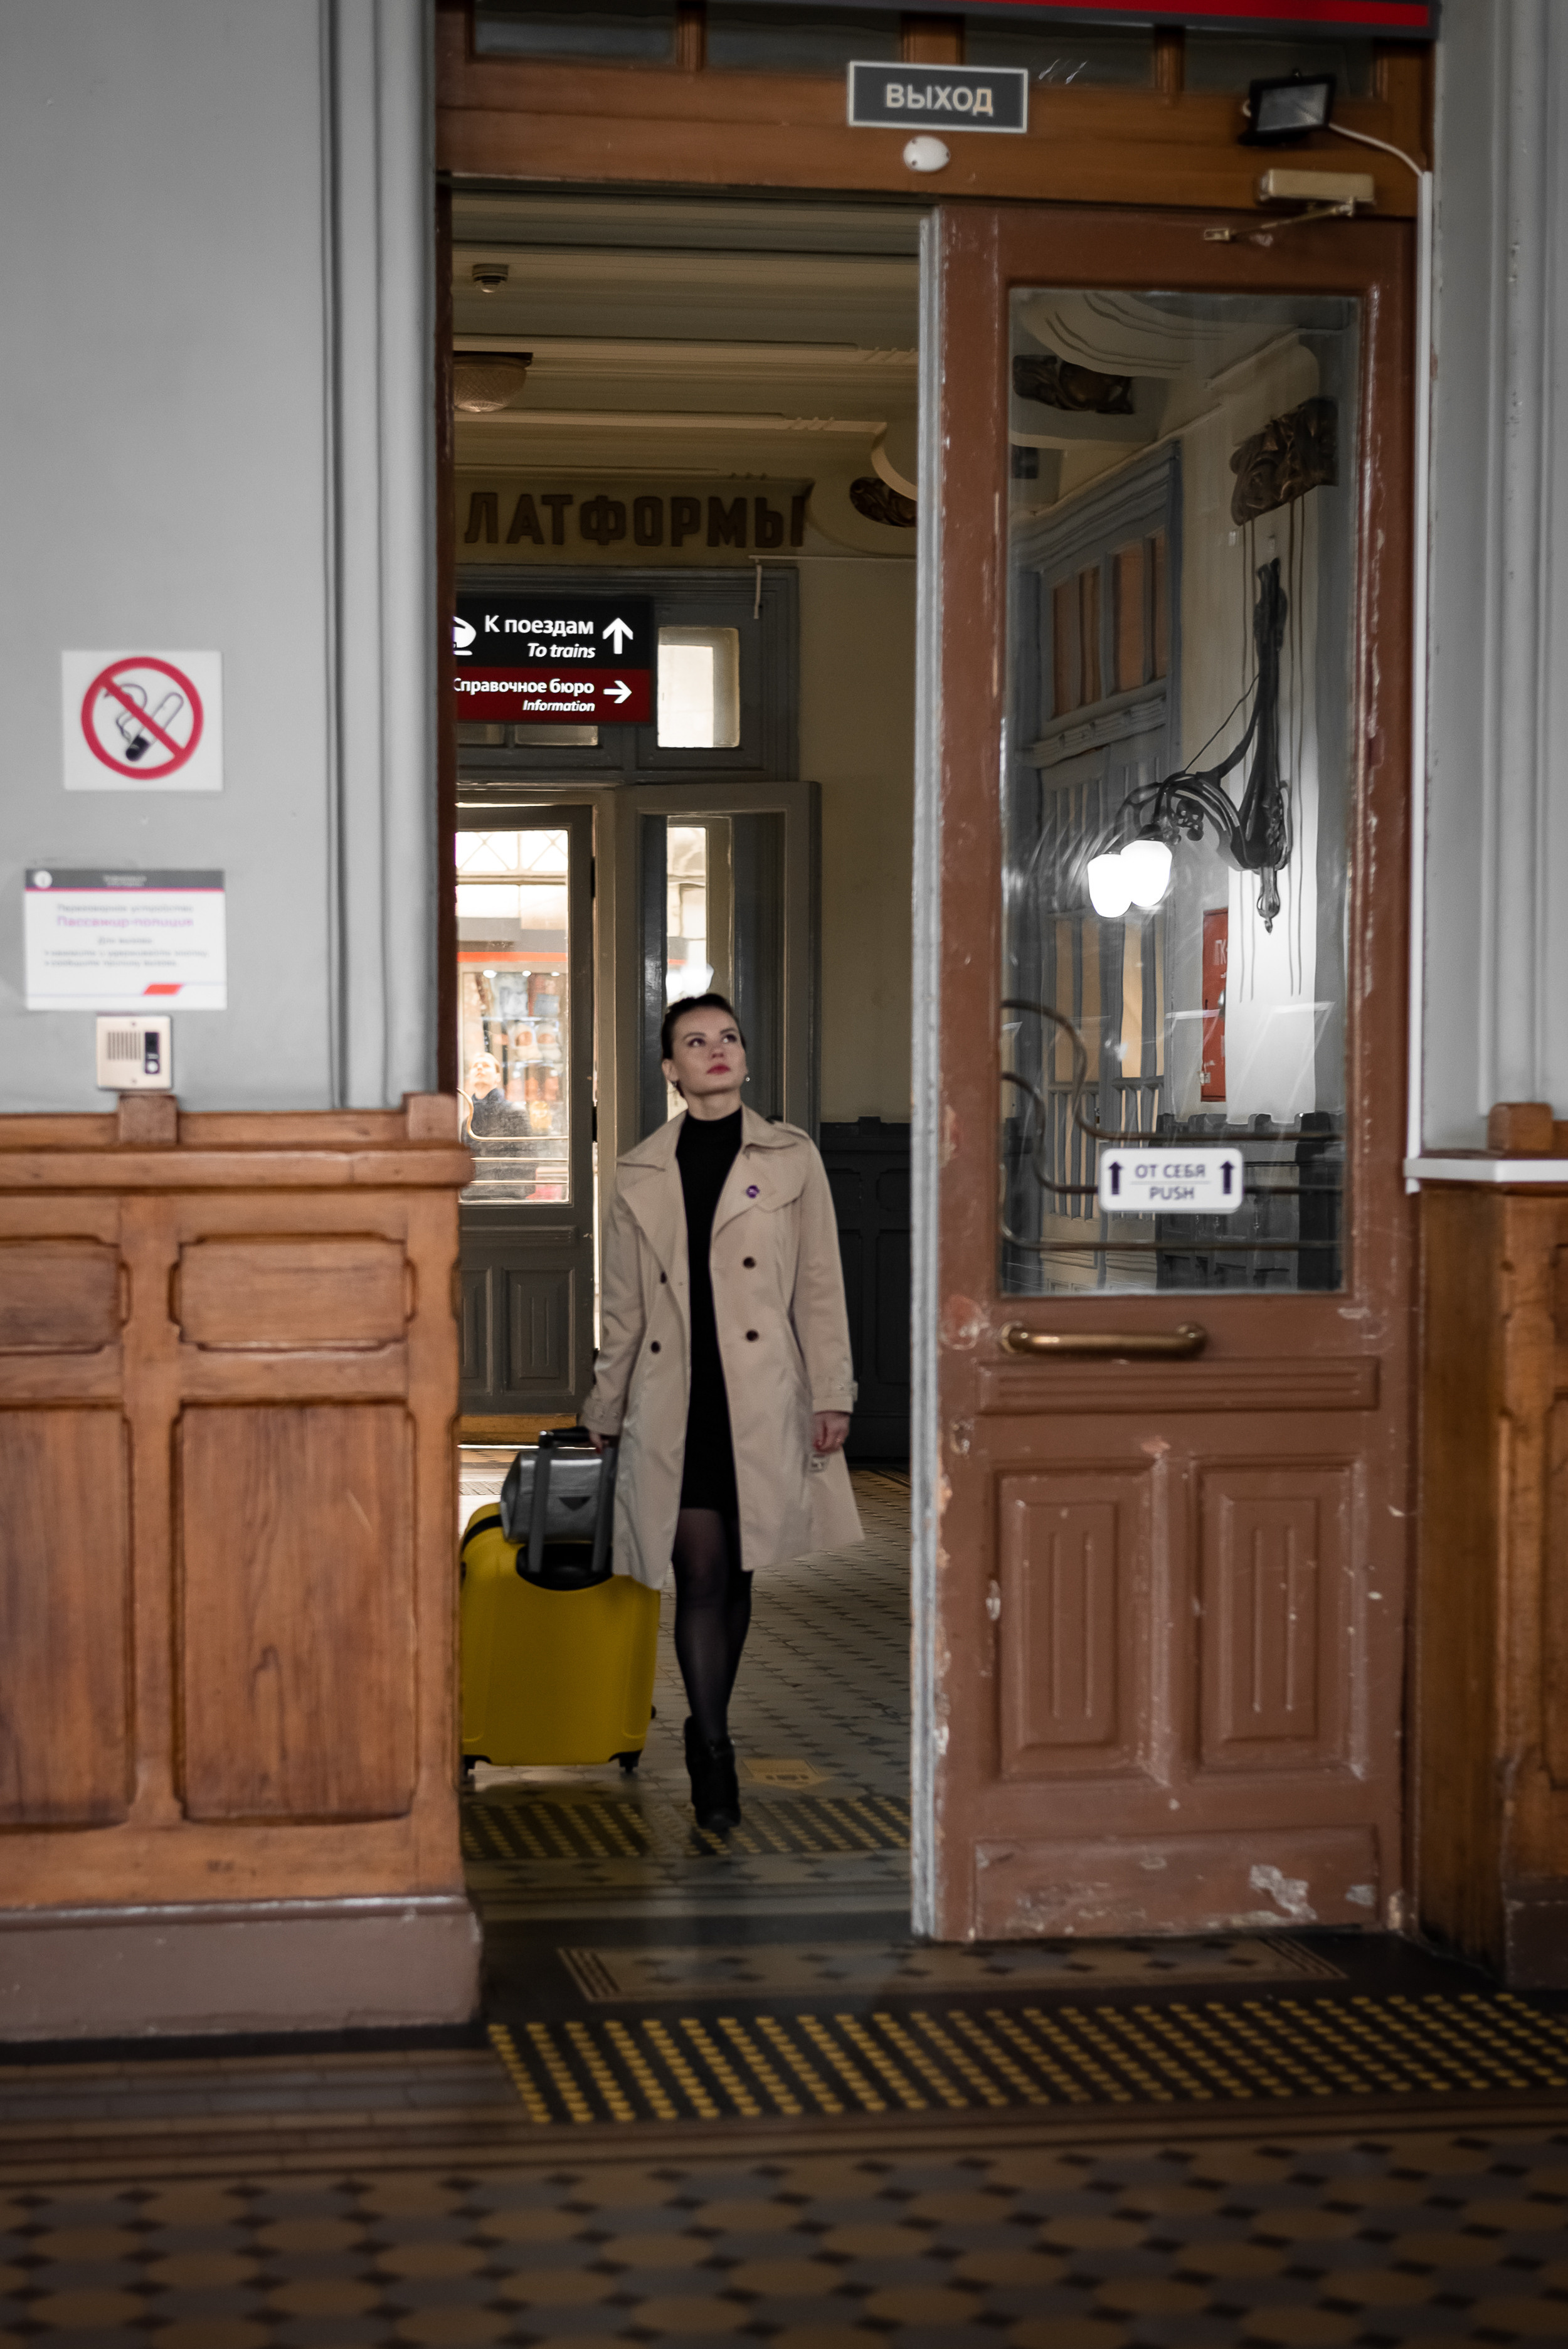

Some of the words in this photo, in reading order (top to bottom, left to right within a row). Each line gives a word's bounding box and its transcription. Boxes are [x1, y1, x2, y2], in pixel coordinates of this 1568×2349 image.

[885, 83, 993, 117] ВЫХОД
[484, 615, 500, 632] К
[504, 618, 594, 637] поездам
[527, 643, 547, 657] To
[549, 643, 596, 659] trains
[453, 678, 547, 695] Справочное
[549, 678, 595, 696] бюро
[522, 699, 595, 712] Information
[1135, 1164, 1157, 1179] ОТ
[1163, 1164, 1206, 1178] СЕБЯ
[1149, 1186, 1195, 1200] PUSH
